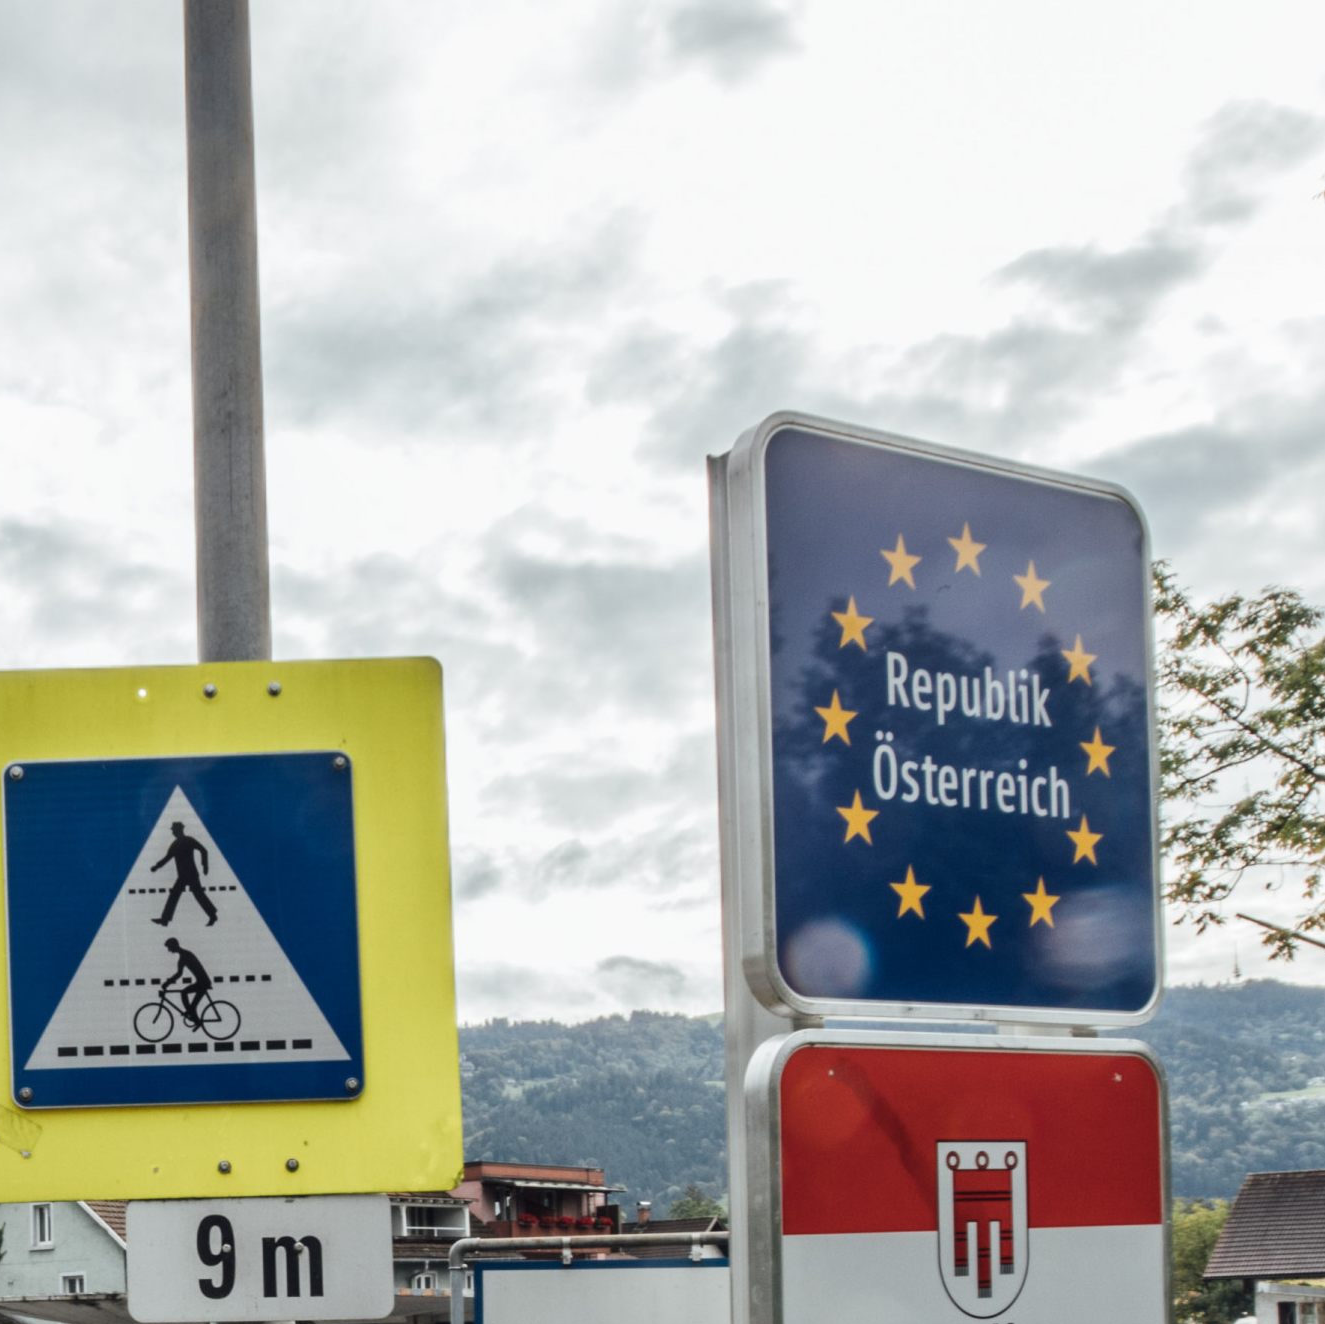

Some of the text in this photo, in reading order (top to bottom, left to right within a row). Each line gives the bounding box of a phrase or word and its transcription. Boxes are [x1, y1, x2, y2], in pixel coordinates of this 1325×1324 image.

[887, 651, 1052, 727] Republik
[873, 730, 1070, 819] Österreich
[196, 1214, 324, 1299] 9 m
